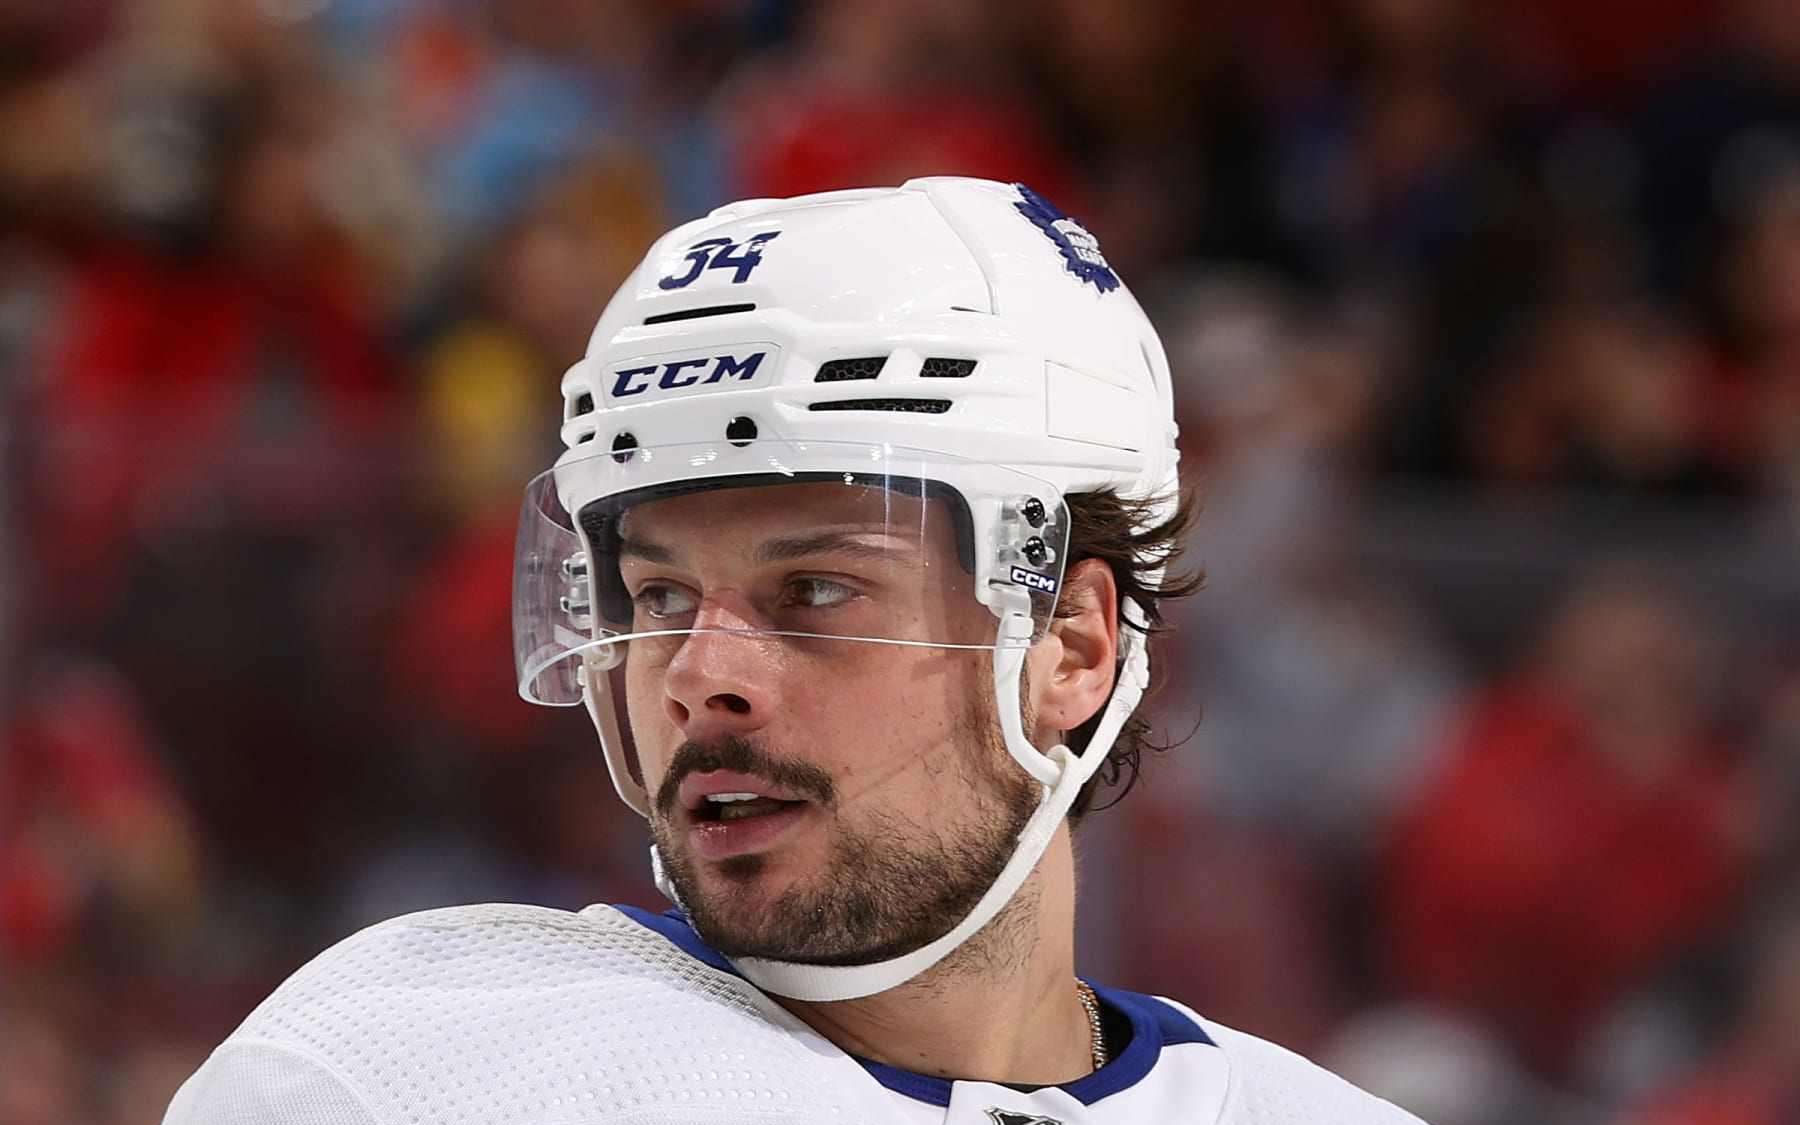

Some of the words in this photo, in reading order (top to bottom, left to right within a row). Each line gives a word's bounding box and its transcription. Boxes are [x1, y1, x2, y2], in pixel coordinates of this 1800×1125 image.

[658, 231, 782, 290] 34
[611, 352, 767, 398] CCM
[1011, 568, 1056, 592] CCM
